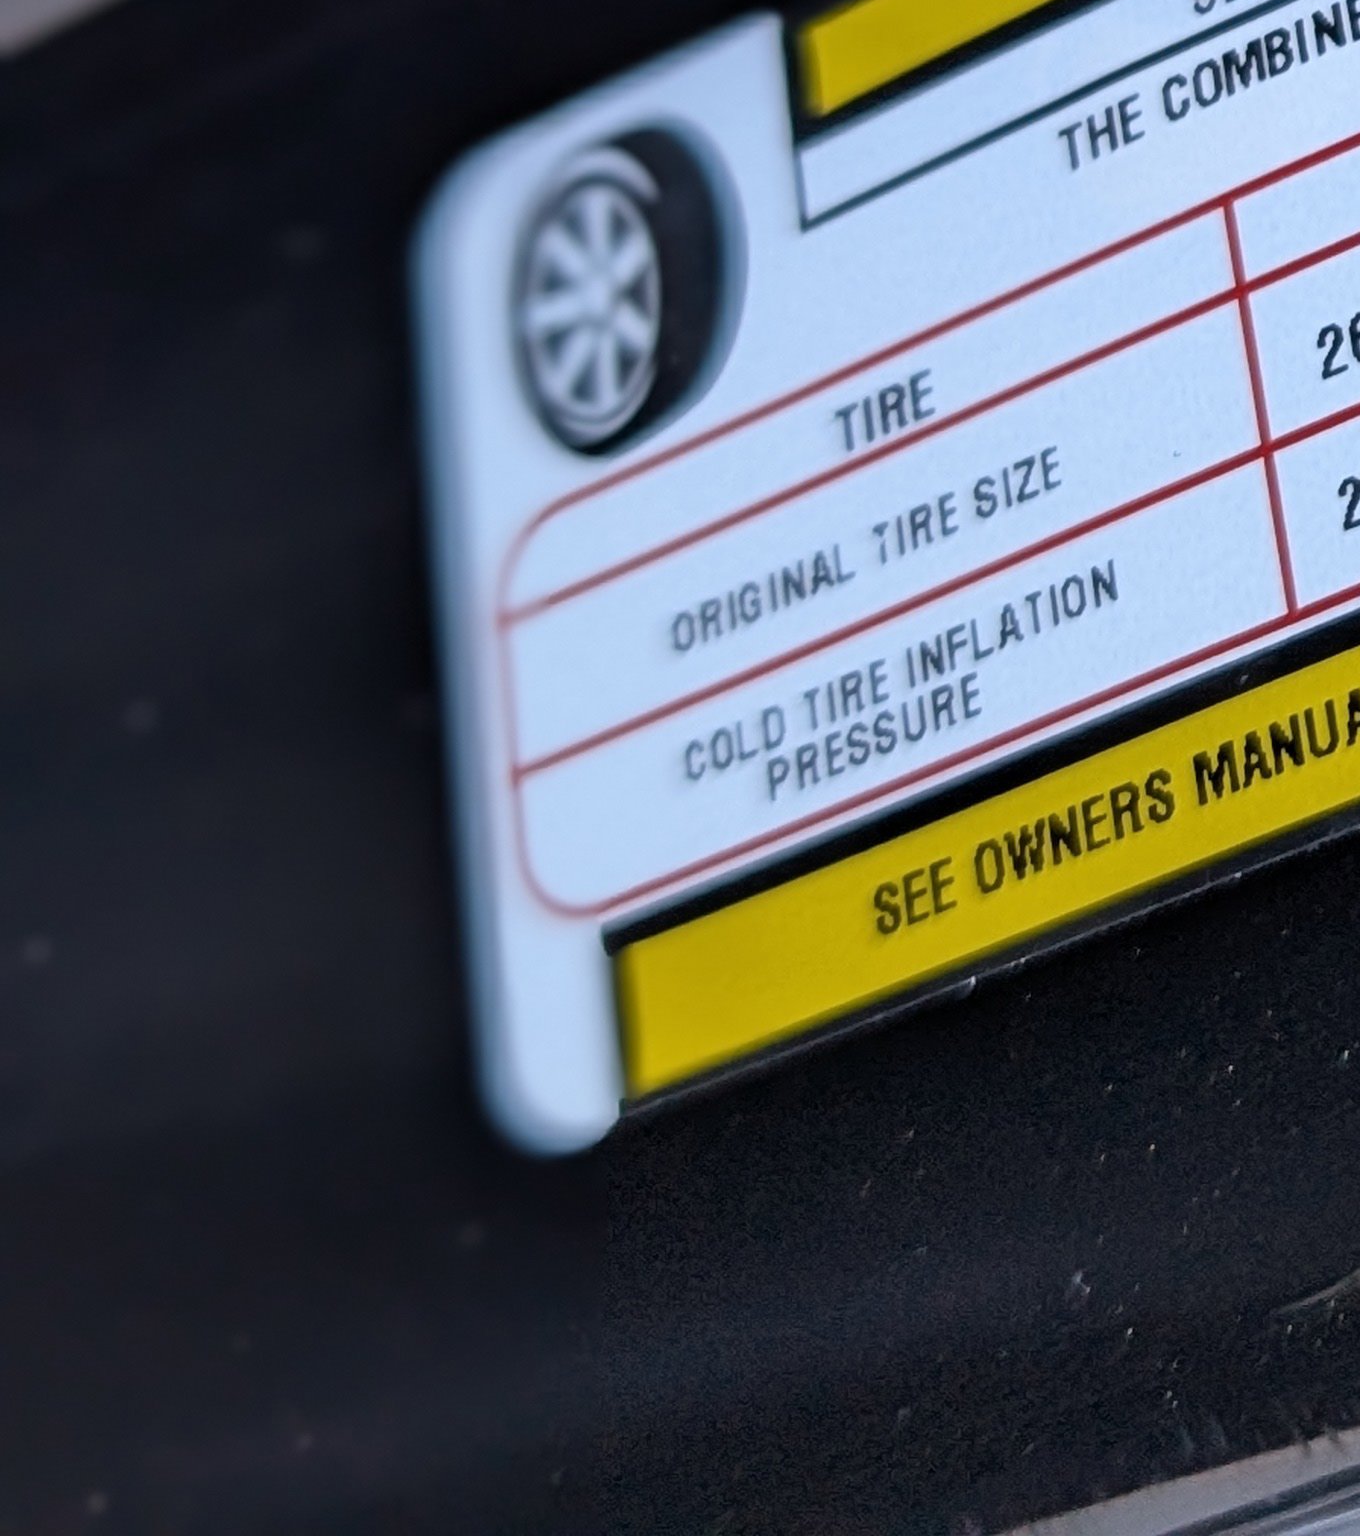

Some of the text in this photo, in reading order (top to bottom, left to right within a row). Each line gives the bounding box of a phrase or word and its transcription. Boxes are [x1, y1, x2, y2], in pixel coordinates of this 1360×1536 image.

[1056, 91, 1145, 171] THE
[832, 367, 935, 453] TIRE
[669, 444, 1063, 654] ORIGINAL TIRE SIZE
[681, 557, 1120, 783] COLD TIRE INFLATION
[764, 670, 983, 802] PRESSURE
[871, 854, 958, 937] SEE
[971, 767, 1176, 896] OWNERS
